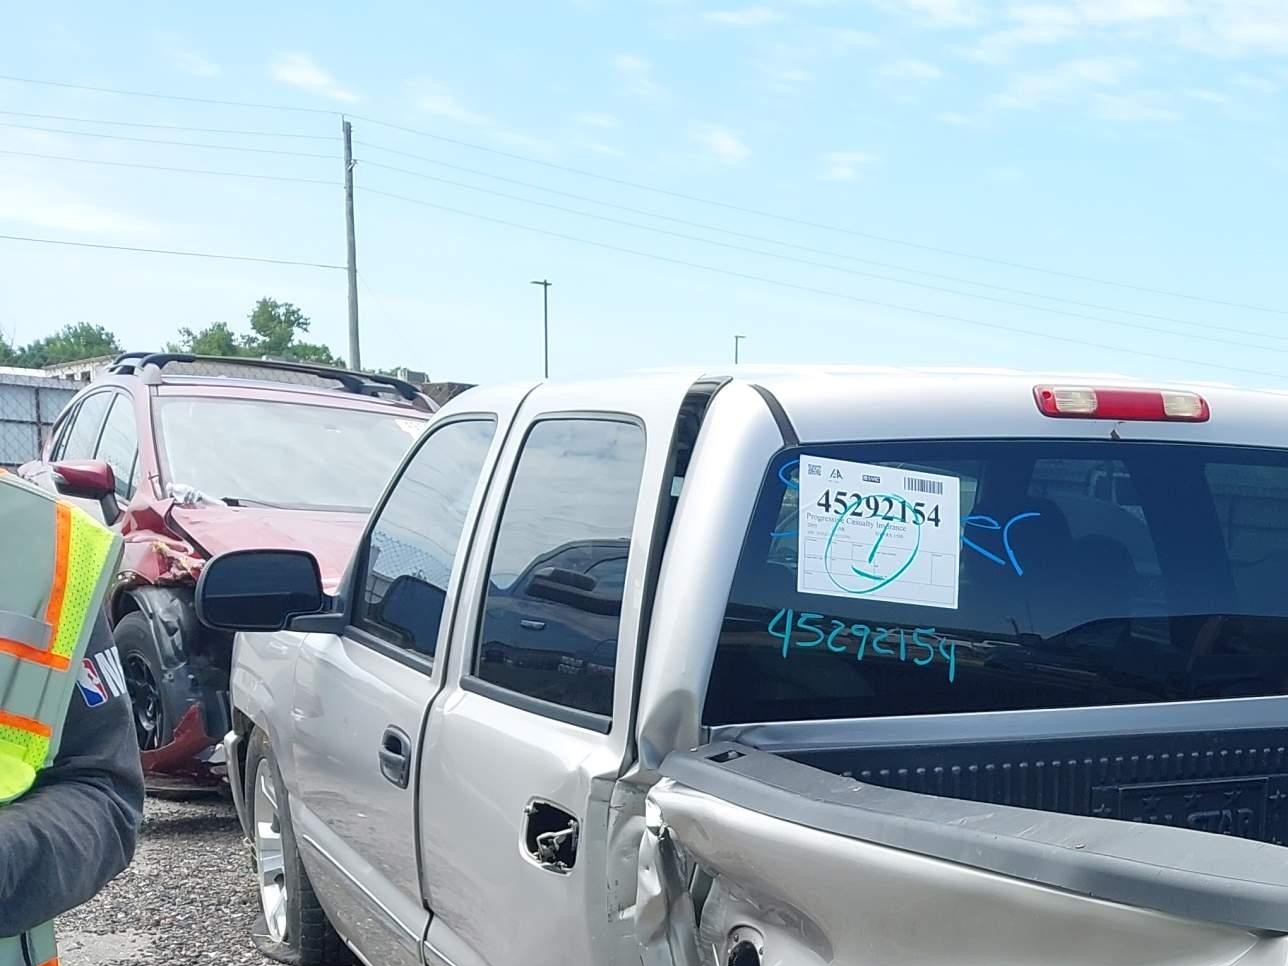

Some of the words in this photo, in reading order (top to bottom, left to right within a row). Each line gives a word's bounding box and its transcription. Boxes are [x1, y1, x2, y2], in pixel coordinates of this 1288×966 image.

[806, 512, 845, 525] Progressie
[846, 517, 875, 530] Casualty
[816, 488, 941, 528] 45292154
[767, 607, 956, 683] 45292154
